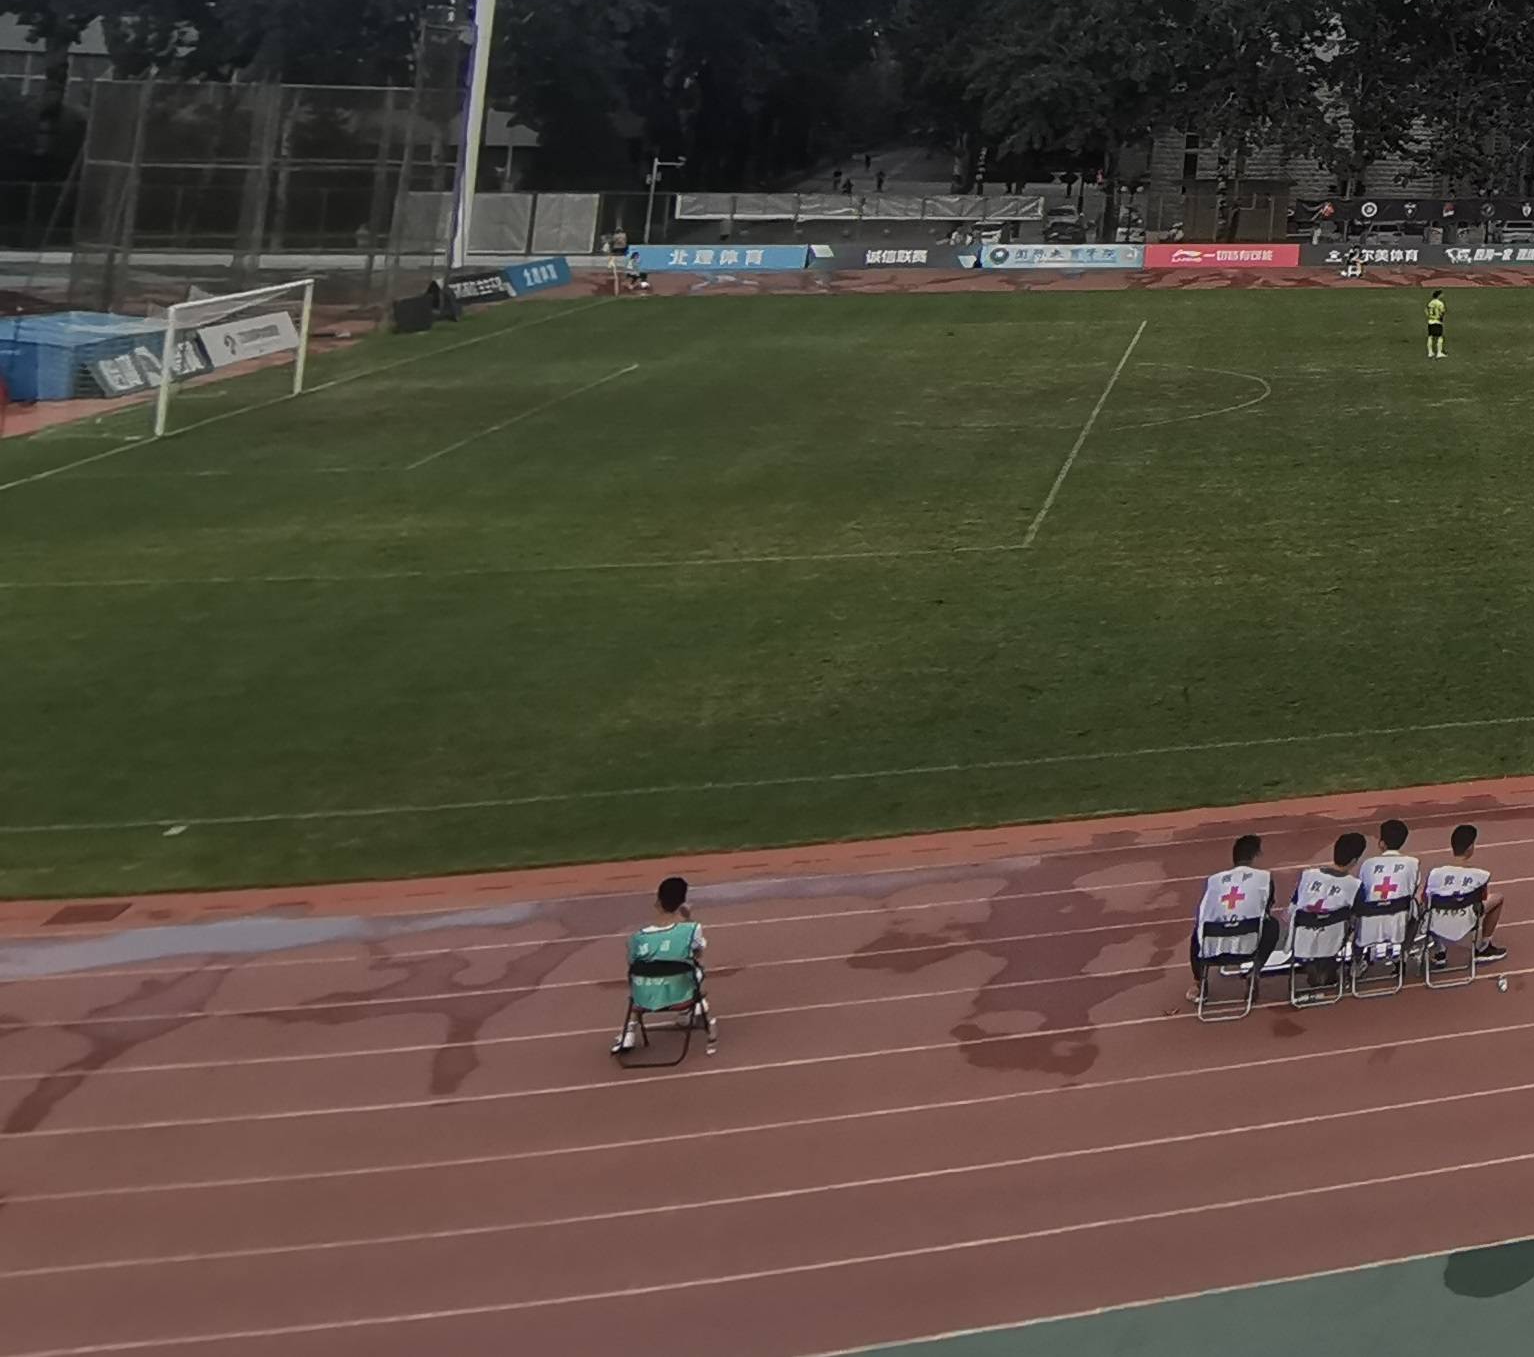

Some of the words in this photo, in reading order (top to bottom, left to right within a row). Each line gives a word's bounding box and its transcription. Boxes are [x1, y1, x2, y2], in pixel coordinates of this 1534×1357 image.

[669, 250, 763, 265] 北理体育
[866, 249, 928, 264] 诚信联赛
